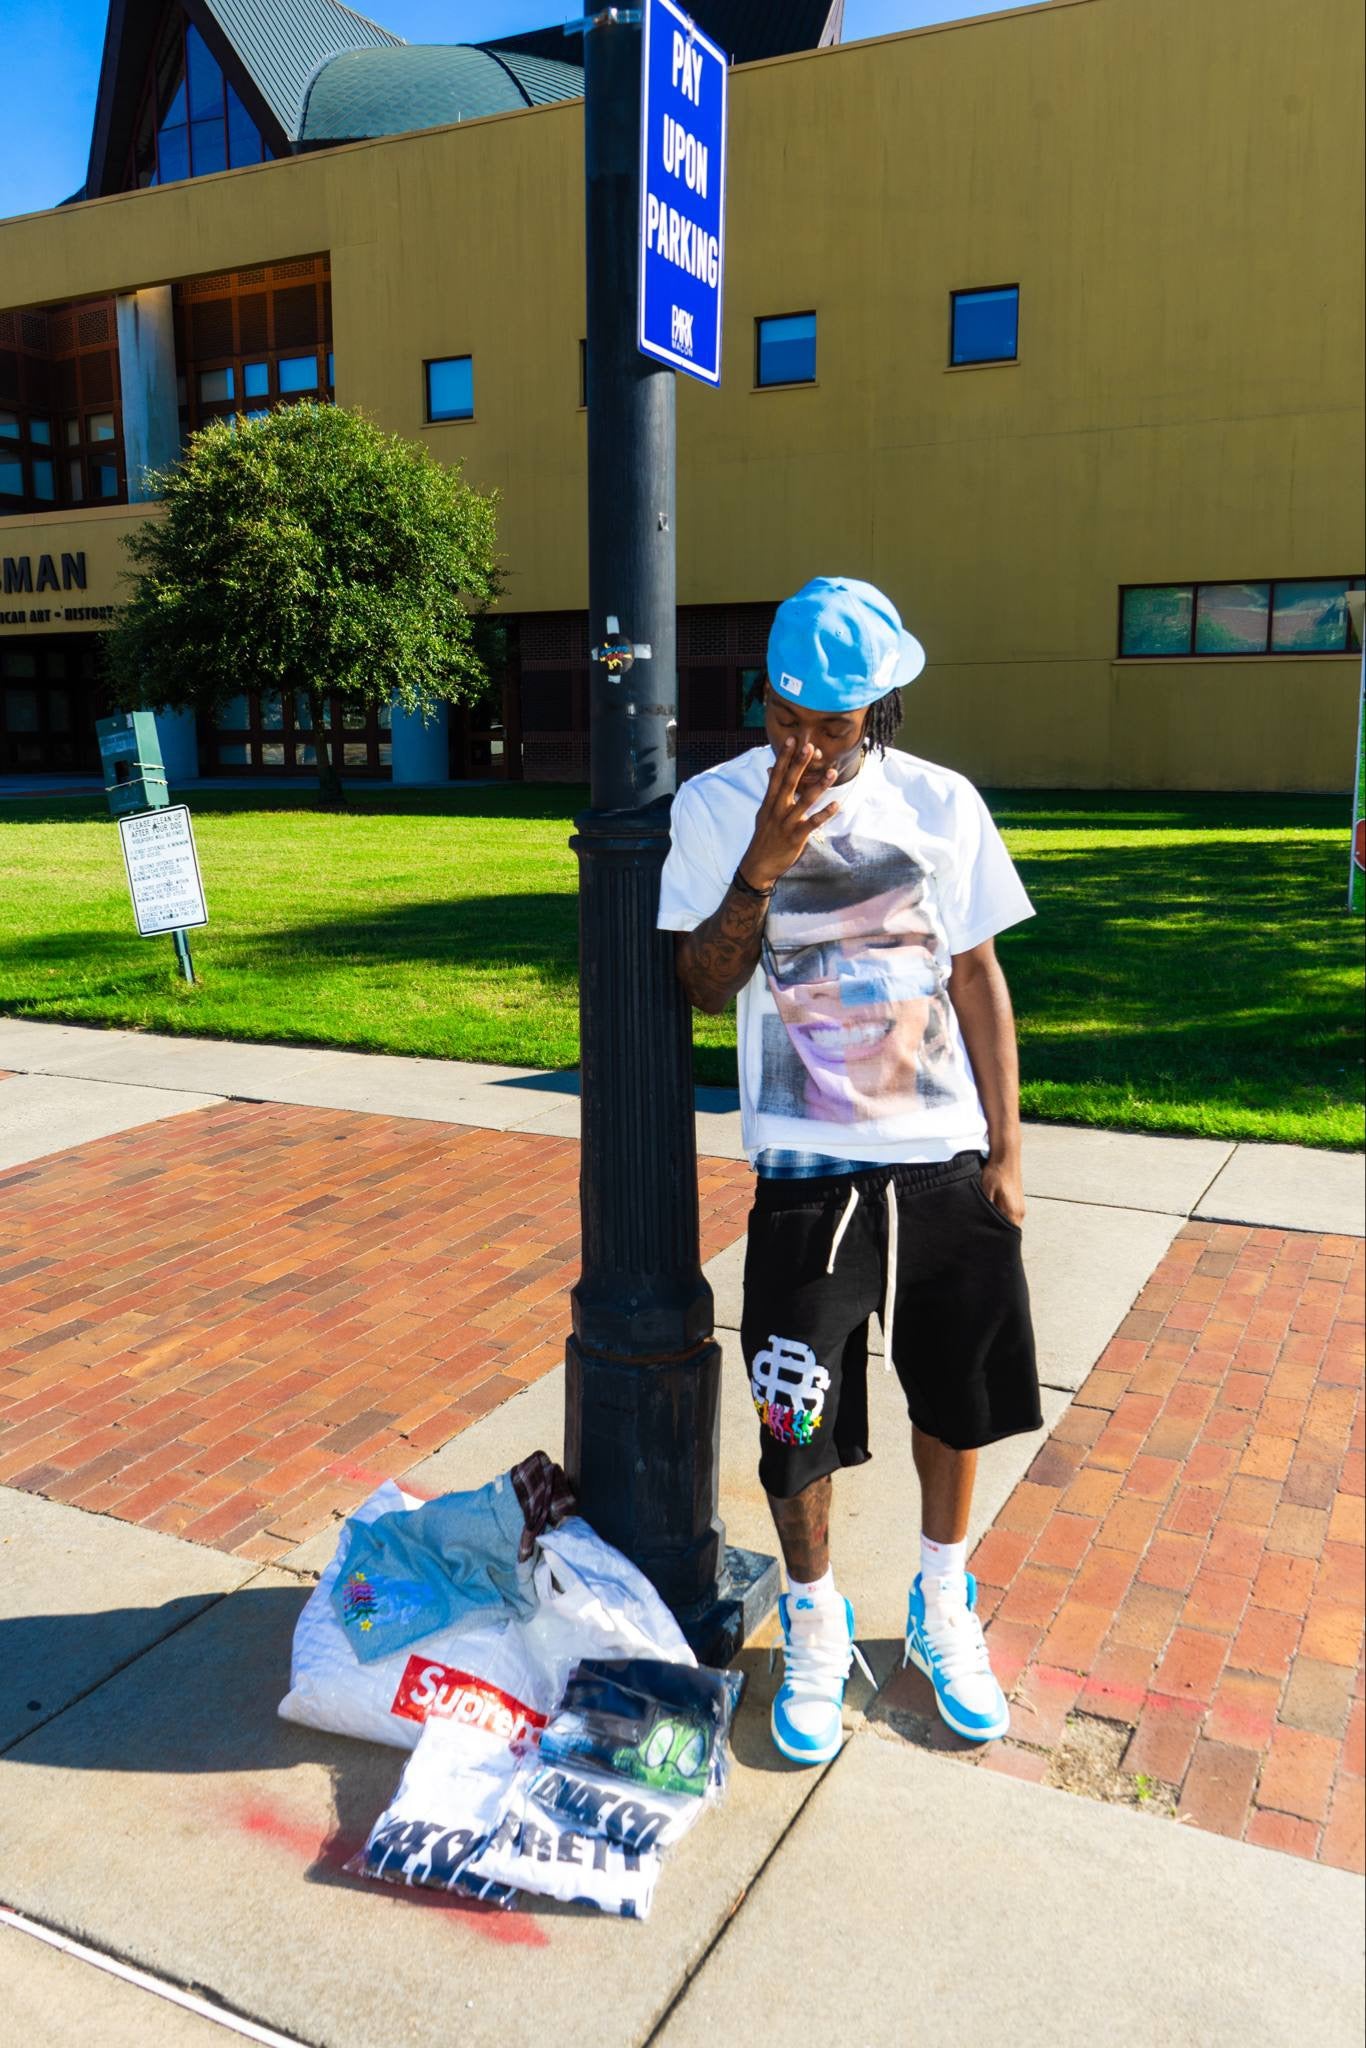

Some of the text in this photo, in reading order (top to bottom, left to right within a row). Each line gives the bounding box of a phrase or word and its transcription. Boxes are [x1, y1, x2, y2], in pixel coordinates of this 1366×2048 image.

[672, 29, 703, 107] PAY
[662, 113, 708, 200] UPON
[647, 192, 718, 289] PARKING
[671, 304, 694, 348] PARK
[0, 552, 87, 593] MAN
[30, 609, 51, 623] ART
[64, 605, 114, 621] HISTORY
[128, 819, 150, 830] PLEASE
[153, 815, 171, 826] CLEAN
[132, 828, 149, 838] AFTER
[409, 1665, 541, 1742] Suprem
